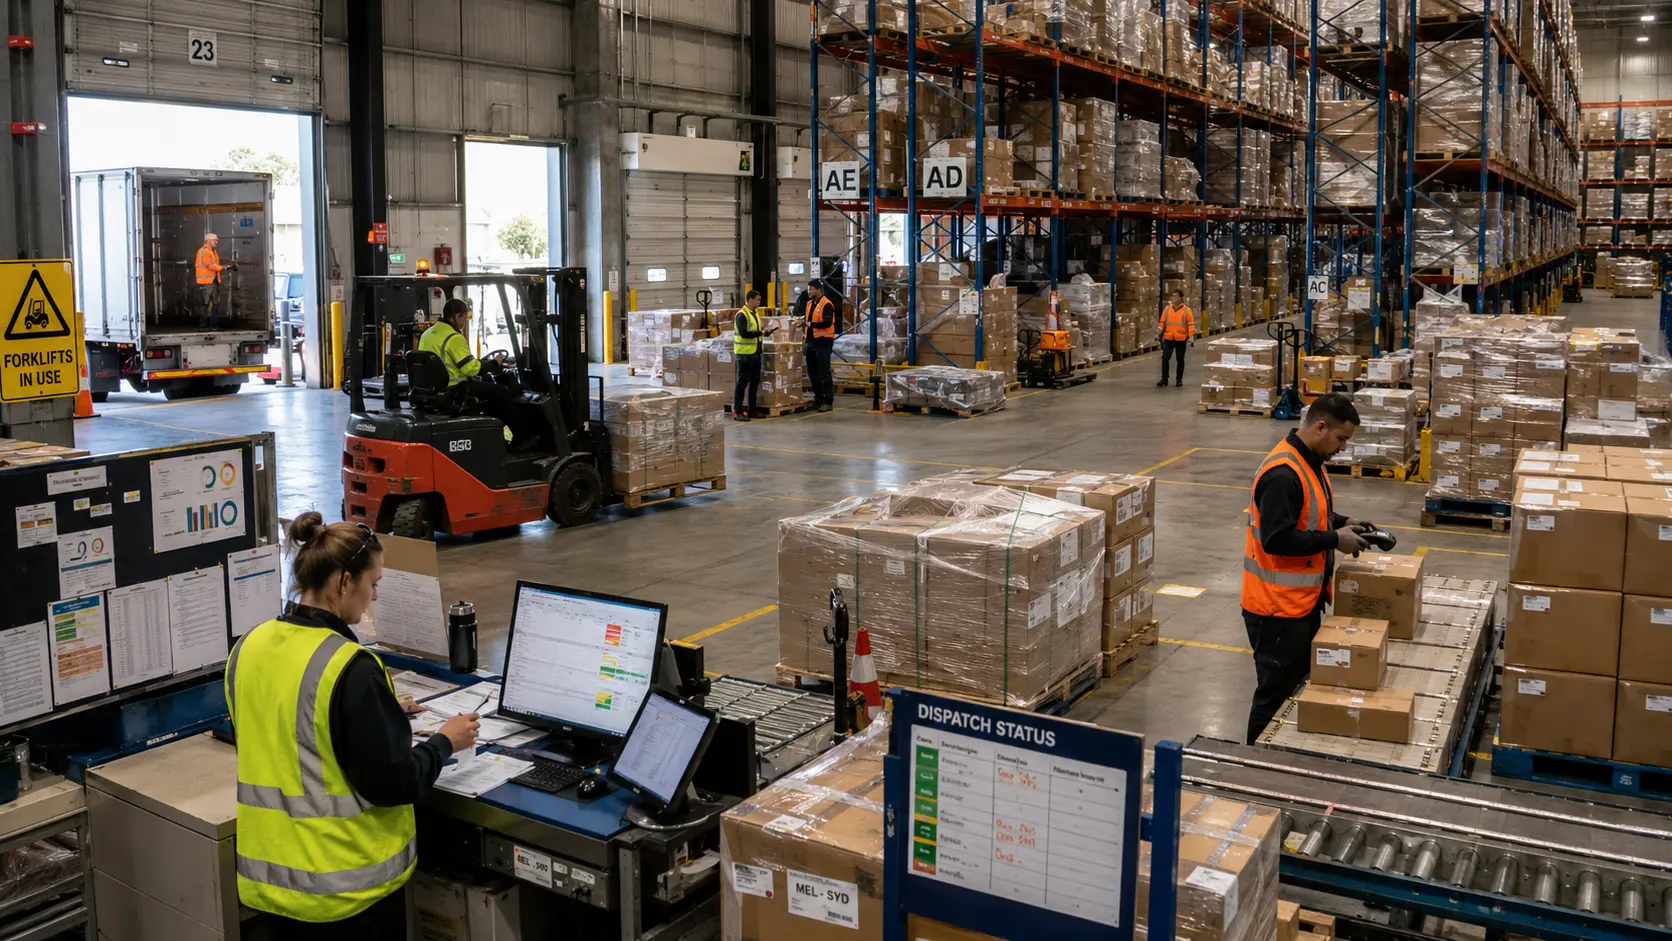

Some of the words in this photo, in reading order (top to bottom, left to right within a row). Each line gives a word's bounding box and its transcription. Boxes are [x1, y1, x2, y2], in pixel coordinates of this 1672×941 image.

[191, 39, 214, 61] 23
[825, 169, 856, 191] AE
[926, 165, 963, 189] AD
[1310, 280, 1326, 293] AC
[4, 349, 73, 368] FORKLIFTS
[20, 372, 33, 387] IN
[36, 370, 61, 385] USE
[918, 703, 991, 733] DISPATCH
[996, 720, 1056, 747] STATUS
[796, 882, 818, 898] MEL
[827, 890, 850, 905] SYD
